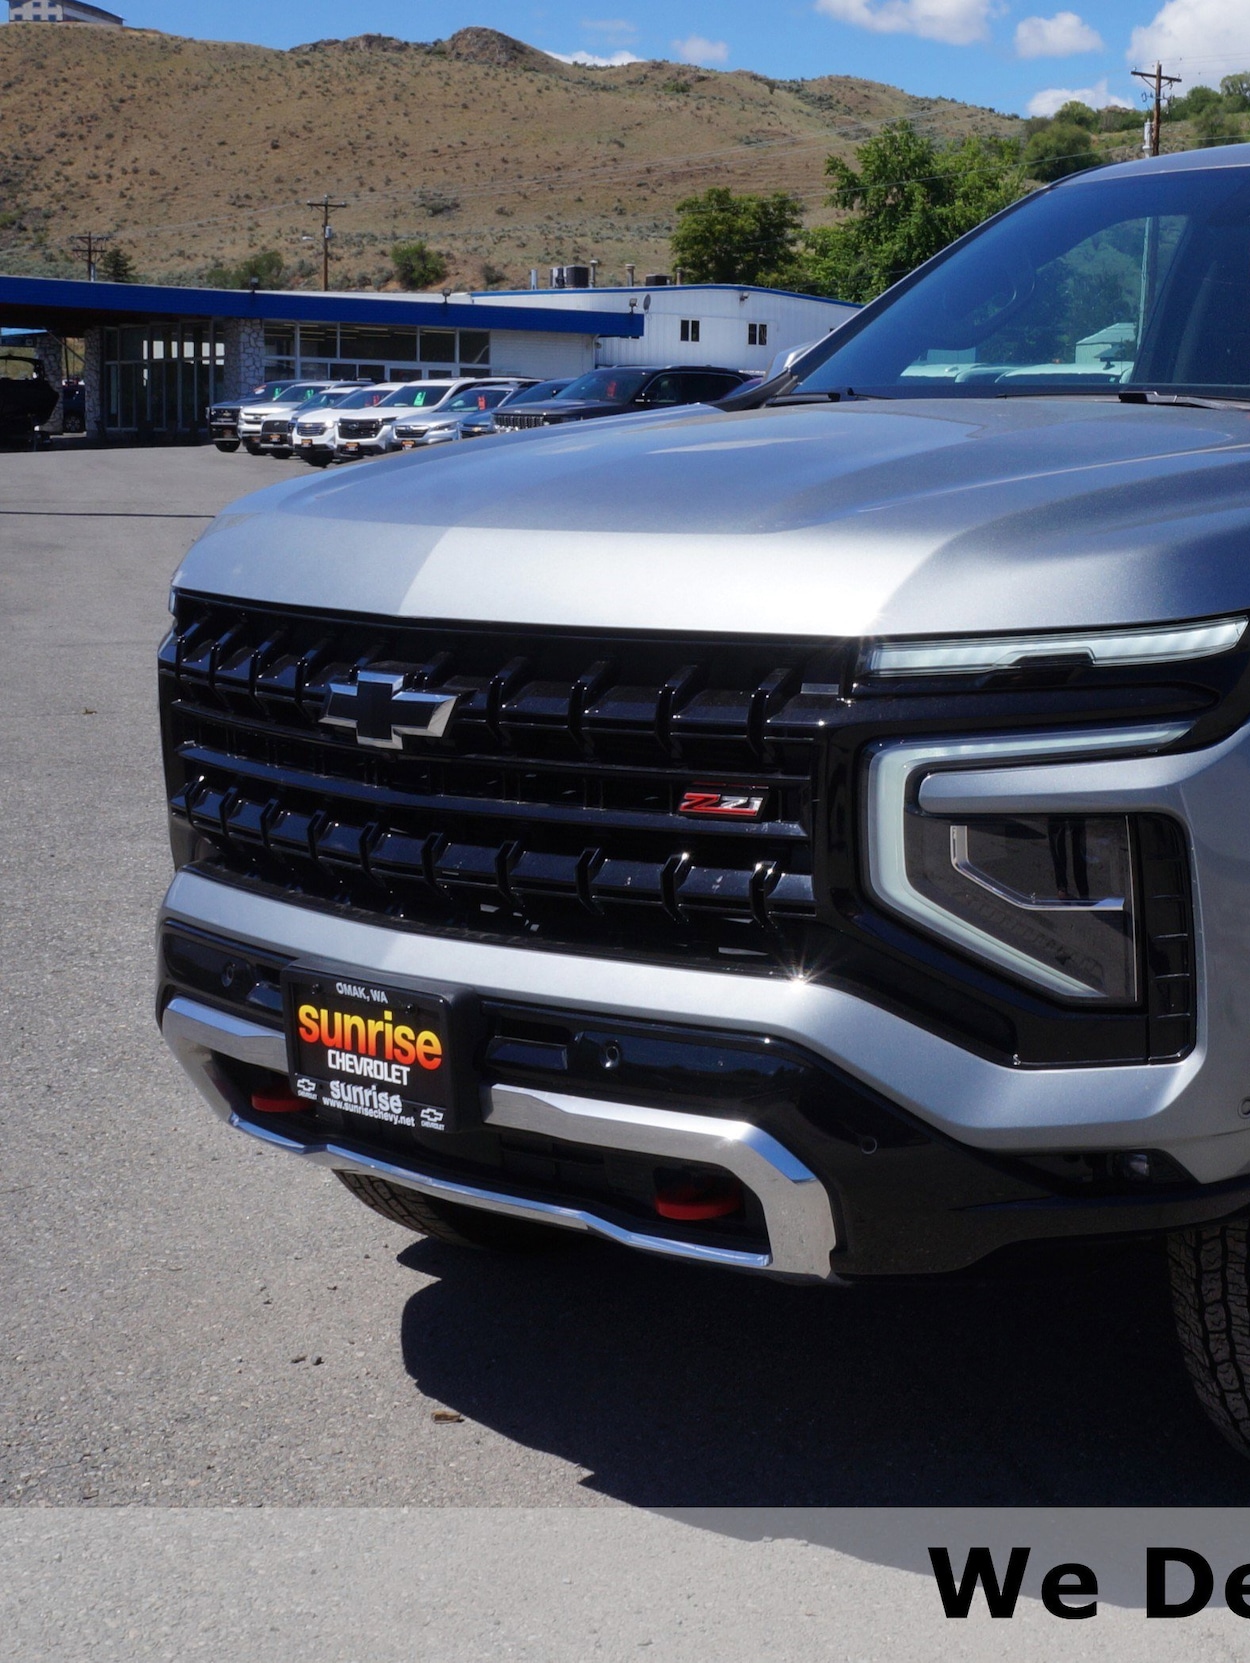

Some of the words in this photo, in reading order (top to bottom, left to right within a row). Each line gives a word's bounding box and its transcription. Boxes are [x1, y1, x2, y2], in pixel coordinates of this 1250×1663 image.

[679, 793, 764, 816] Z71
[336, 982, 370, 1002] OMAK,
[369, 988, 389, 1004] WA
[298, 1004, 443, 1071] sunrise
[327, 1049, 411, 1086] CHEVROLET
[322, 1096, 416, 1127] www.sunrisechevy.net
[330, 1080, 402, 1114] sunrise
